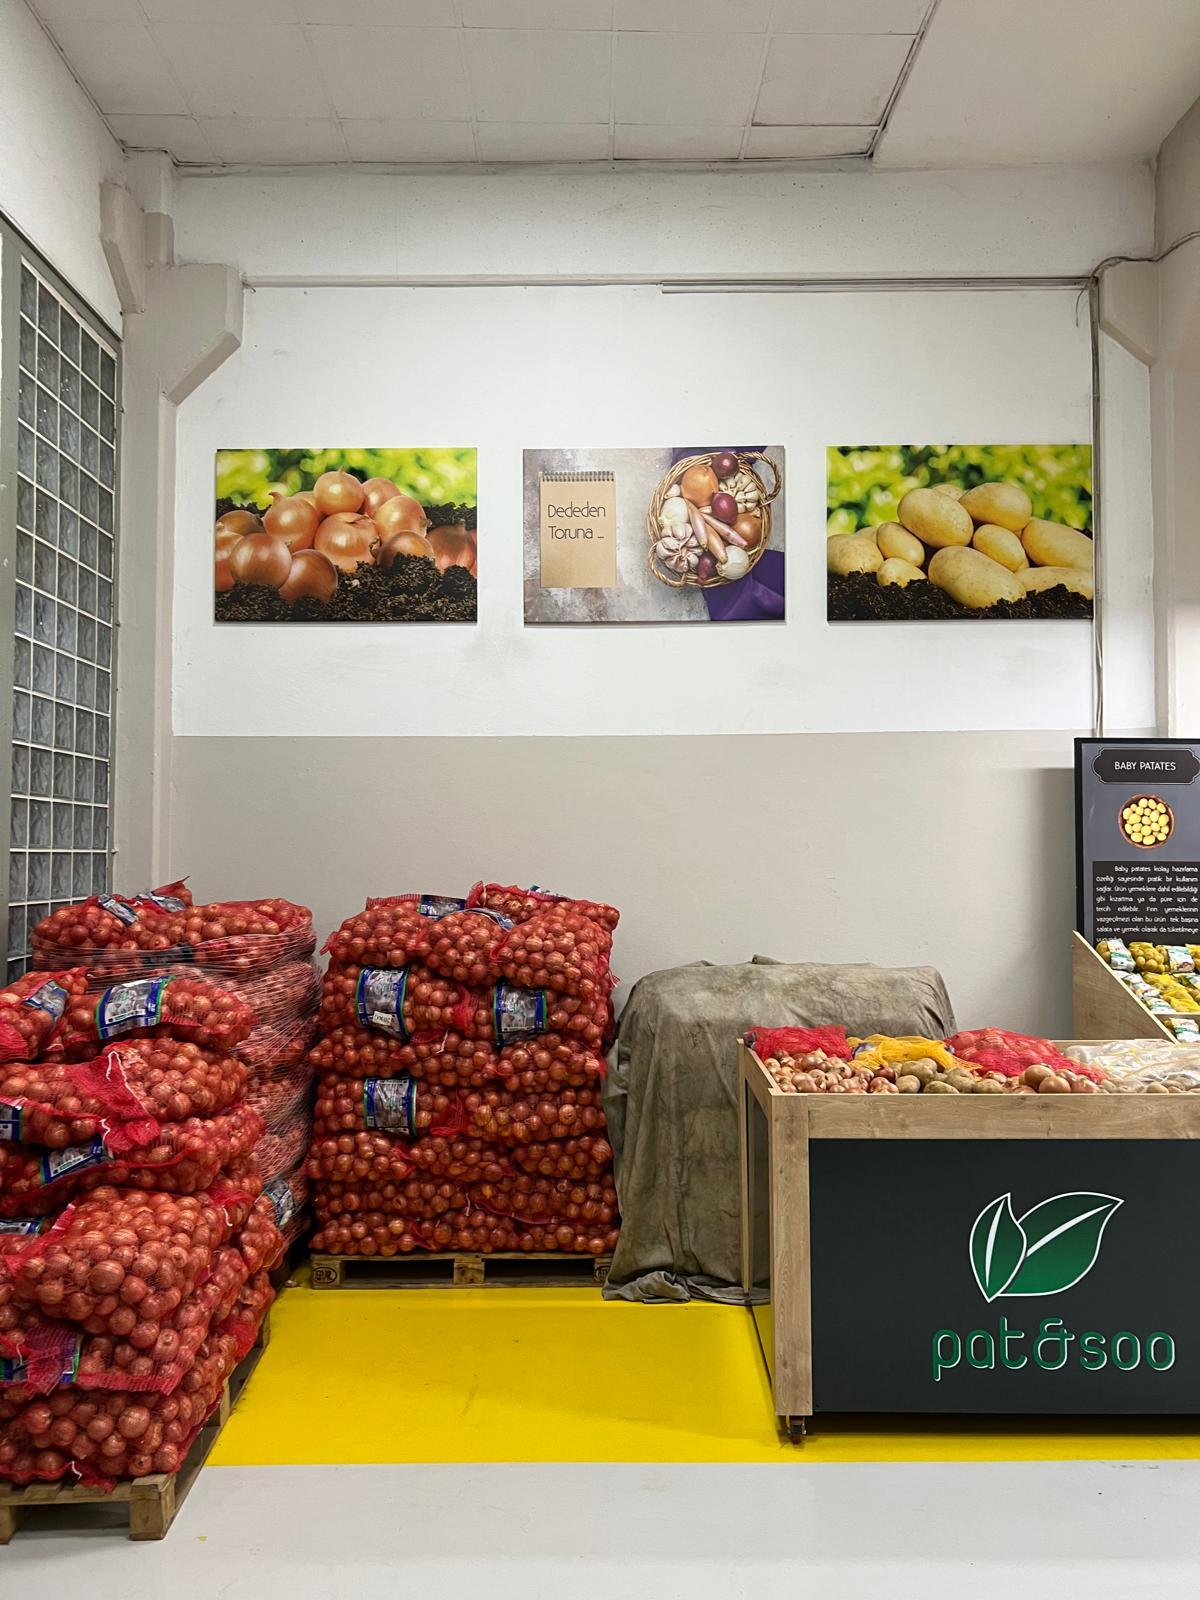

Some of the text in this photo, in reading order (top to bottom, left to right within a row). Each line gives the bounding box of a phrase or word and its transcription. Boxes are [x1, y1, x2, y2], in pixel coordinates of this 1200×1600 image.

[548, 501, 605, 518] Dededen
[548, 525, 593, 539] Toruna
[1114, 761, 1176, 771] BABY PATATES
[1114, 865, 1129, 873] Baby
[1153, 865, 1170, 873] kolay
[1147, 875, 1163, 883] pratik
[1096, 895, 1106, 903] gibi
[933, 1316, 1175, 1381] pat&soo
